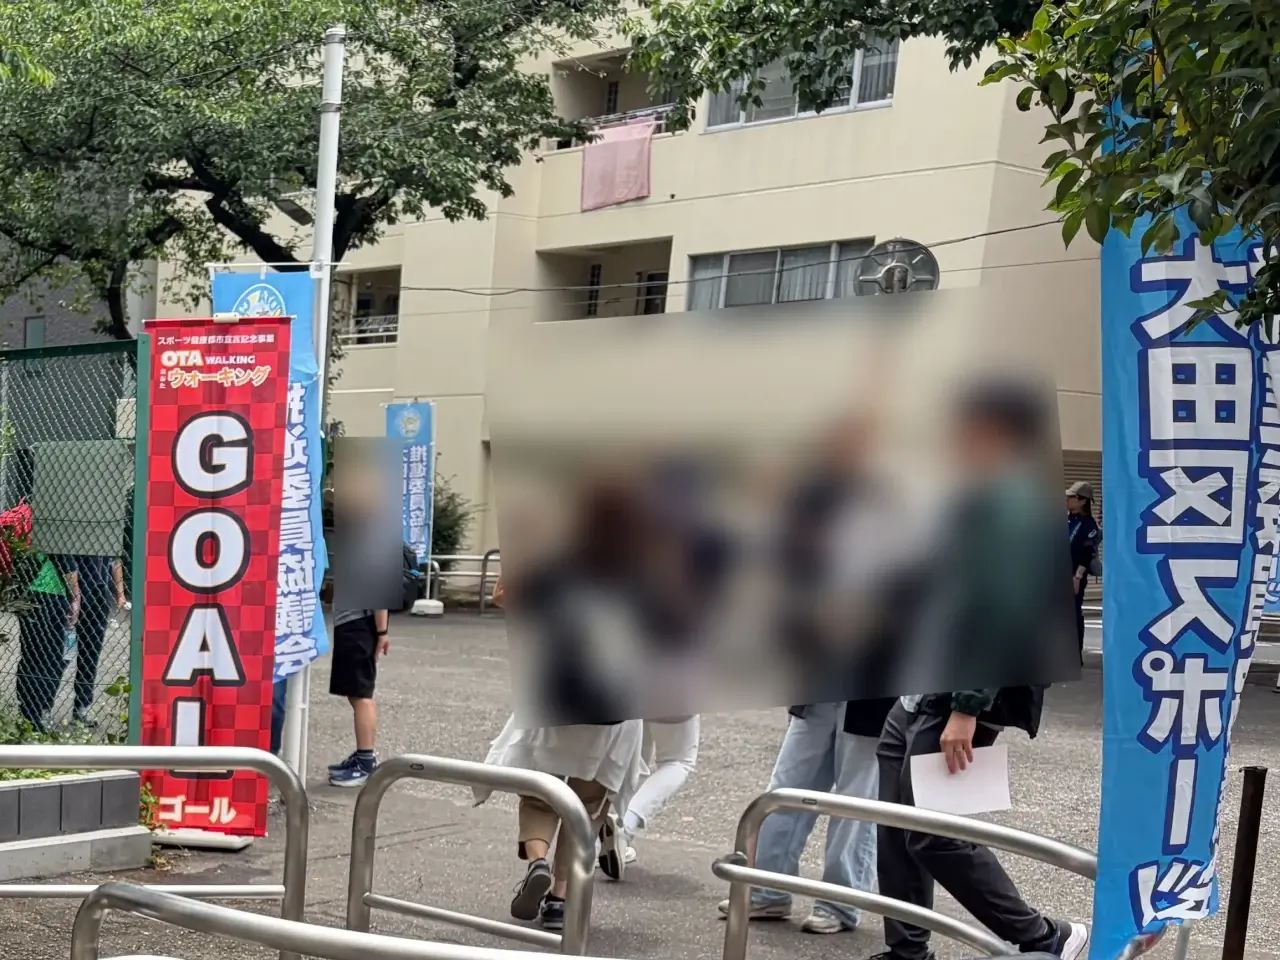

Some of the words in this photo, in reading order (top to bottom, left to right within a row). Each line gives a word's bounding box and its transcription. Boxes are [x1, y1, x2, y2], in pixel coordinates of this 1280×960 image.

[161, 350, 204, 367] OTA
[205, 355, 256, 365] WALKING
[167, 365, 272, 389] ウォーキング
[158, 796, 237, 824] ゴール
